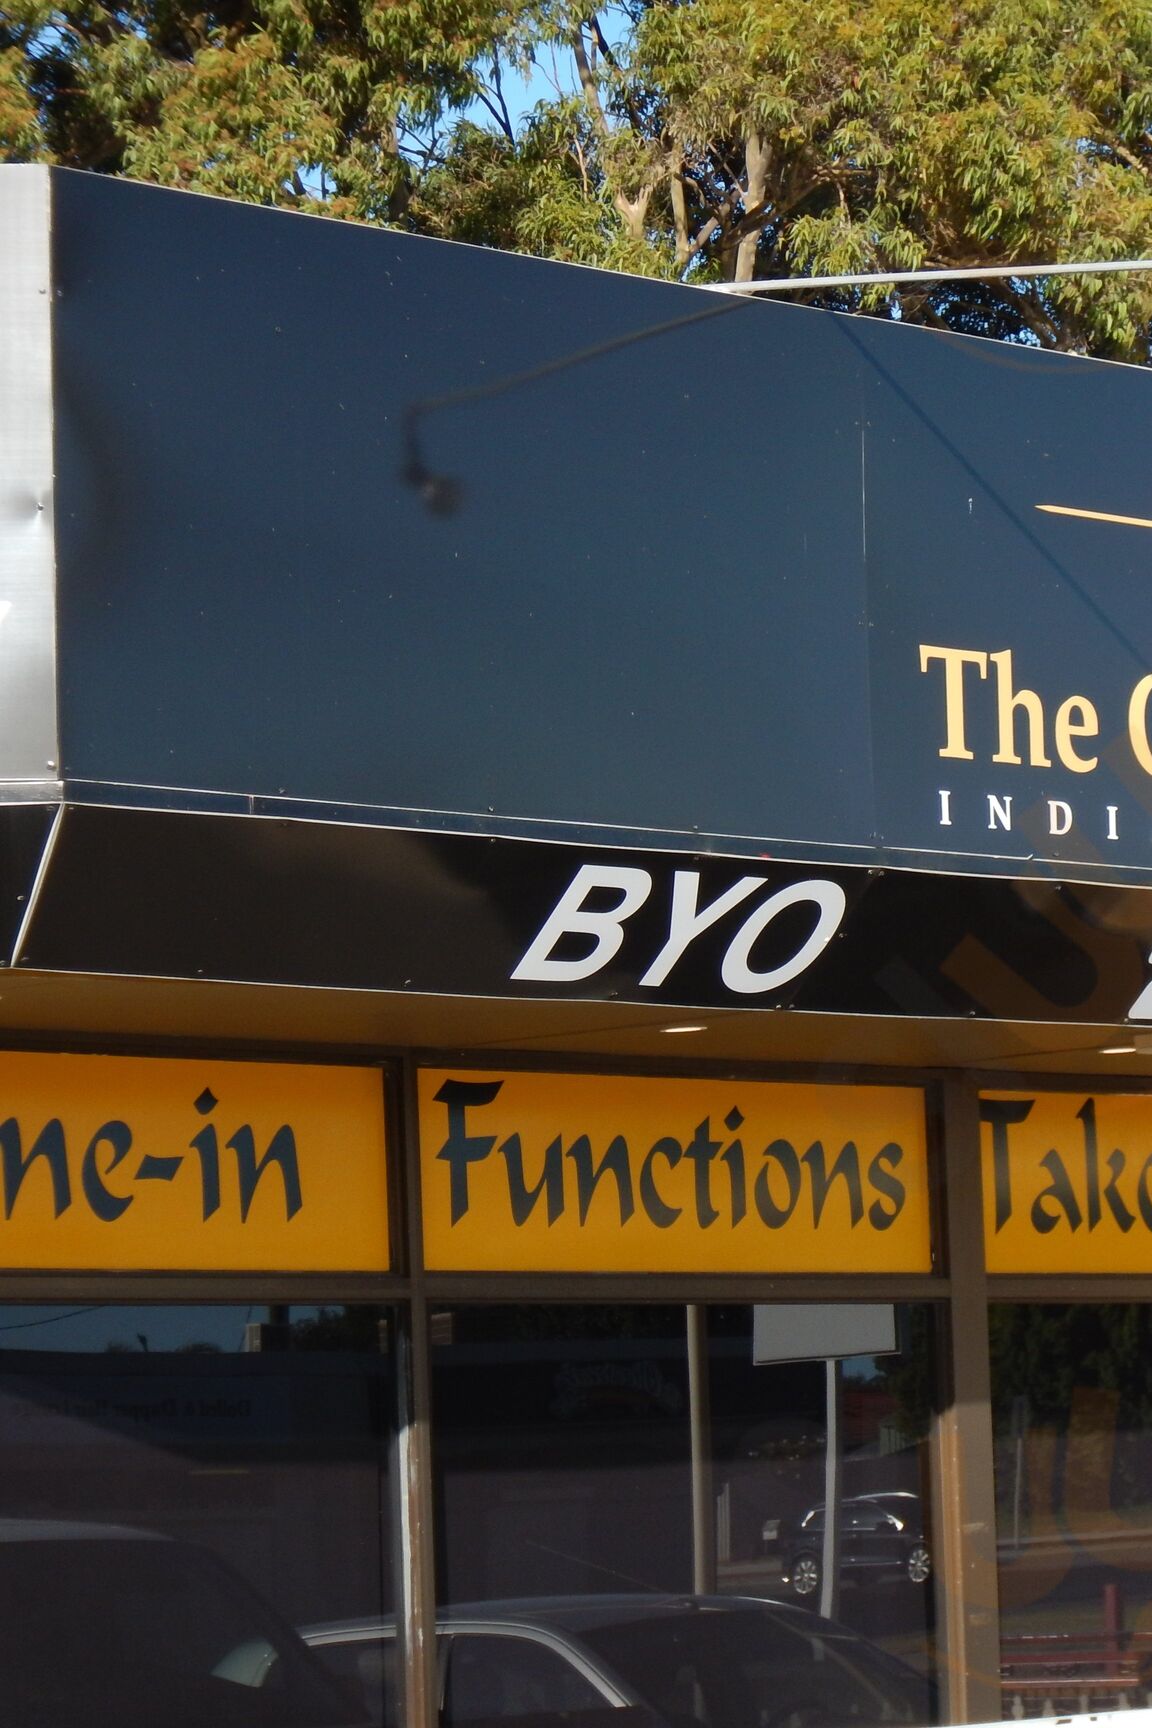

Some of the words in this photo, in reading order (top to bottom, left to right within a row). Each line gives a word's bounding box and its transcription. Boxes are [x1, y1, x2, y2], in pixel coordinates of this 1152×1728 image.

[918, 643, 1099, 774] The
[510, 864, 847, 994] BYO
[432, 1079, 906, 1231] Functions
